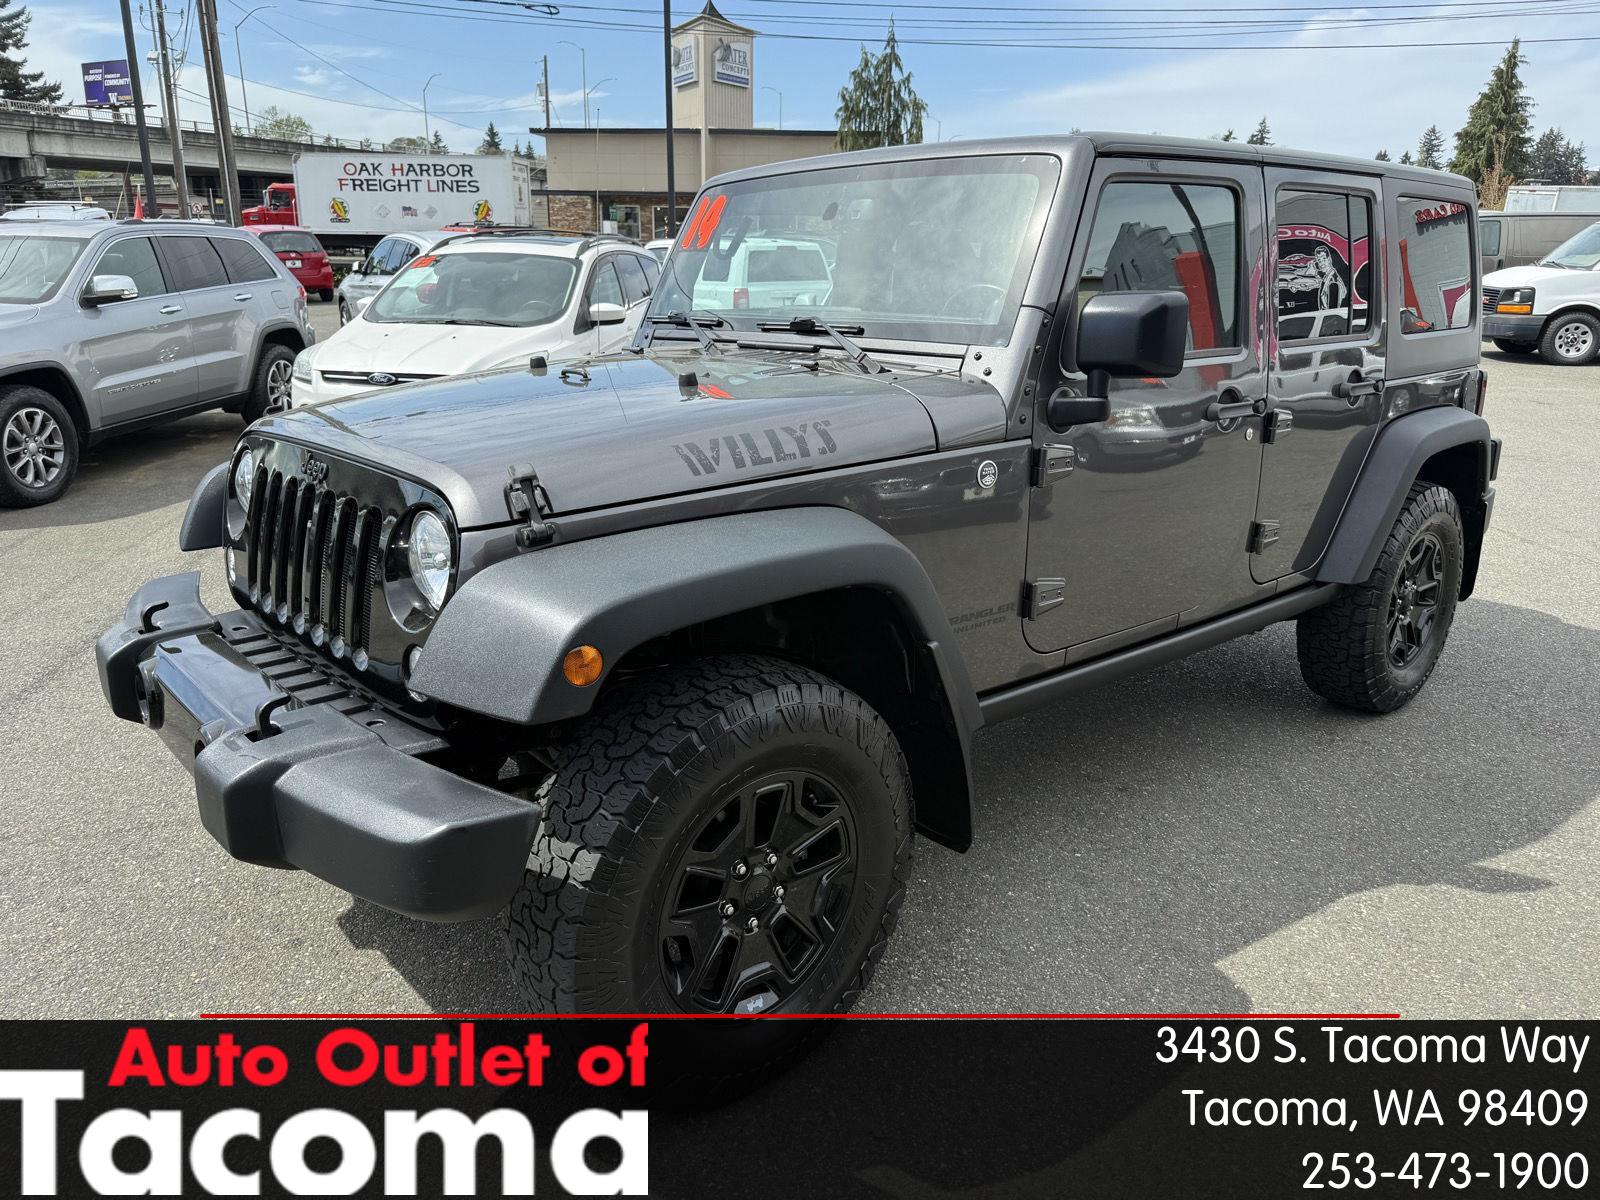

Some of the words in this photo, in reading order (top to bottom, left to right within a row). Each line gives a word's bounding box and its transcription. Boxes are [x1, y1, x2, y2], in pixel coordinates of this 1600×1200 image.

[84, 74, 102, 82] PURPOSE
[104, 78, 129, 86] COMMUNITY
[343, 162, 384, 177] OAK
[391, 163, 474, 178] HARBOR
[338, 178, 422, 192] FREIGHT
[427, 179, 481, 193] LINES
[672, 419, 838, 477] WILLYS
[301, 449, 328, 480] Jeep
[948, 603, 1016, 626] RANGLER
